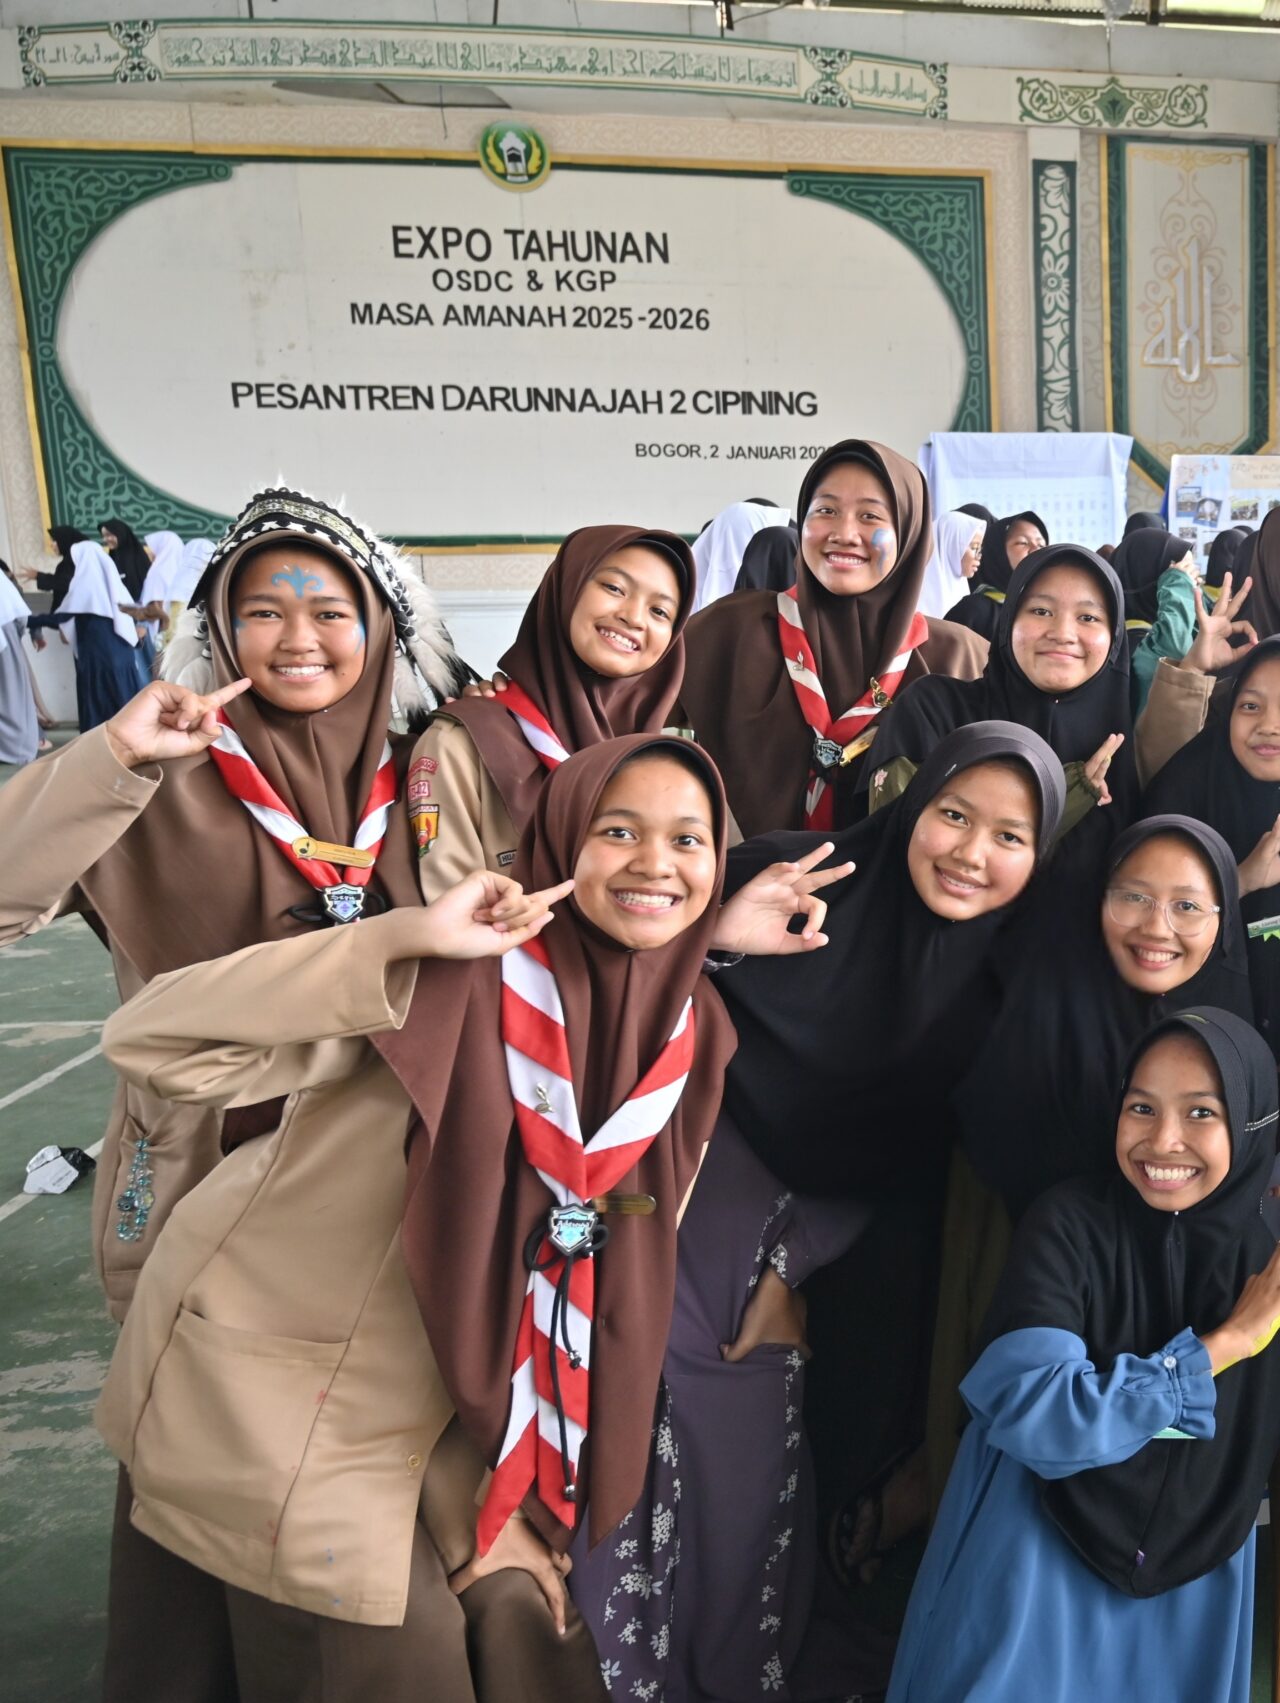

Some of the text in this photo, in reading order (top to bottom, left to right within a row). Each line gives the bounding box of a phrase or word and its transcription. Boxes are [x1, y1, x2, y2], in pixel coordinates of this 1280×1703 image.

[391, 225, 670, 264] EXPO TAHUNAN
[432, 269, 617, 292] OSDC & KGP
[350, 303, 710, 331] MASA AMANAH 2025-2026
[231, 381, 818, 417] PESANTREN DARUNNAJAH 2 CIPINING
[710, 444, 719, 458] 2
[726, 446, 797, 460] JANUARI
[799, 446, 832, 460] 202
